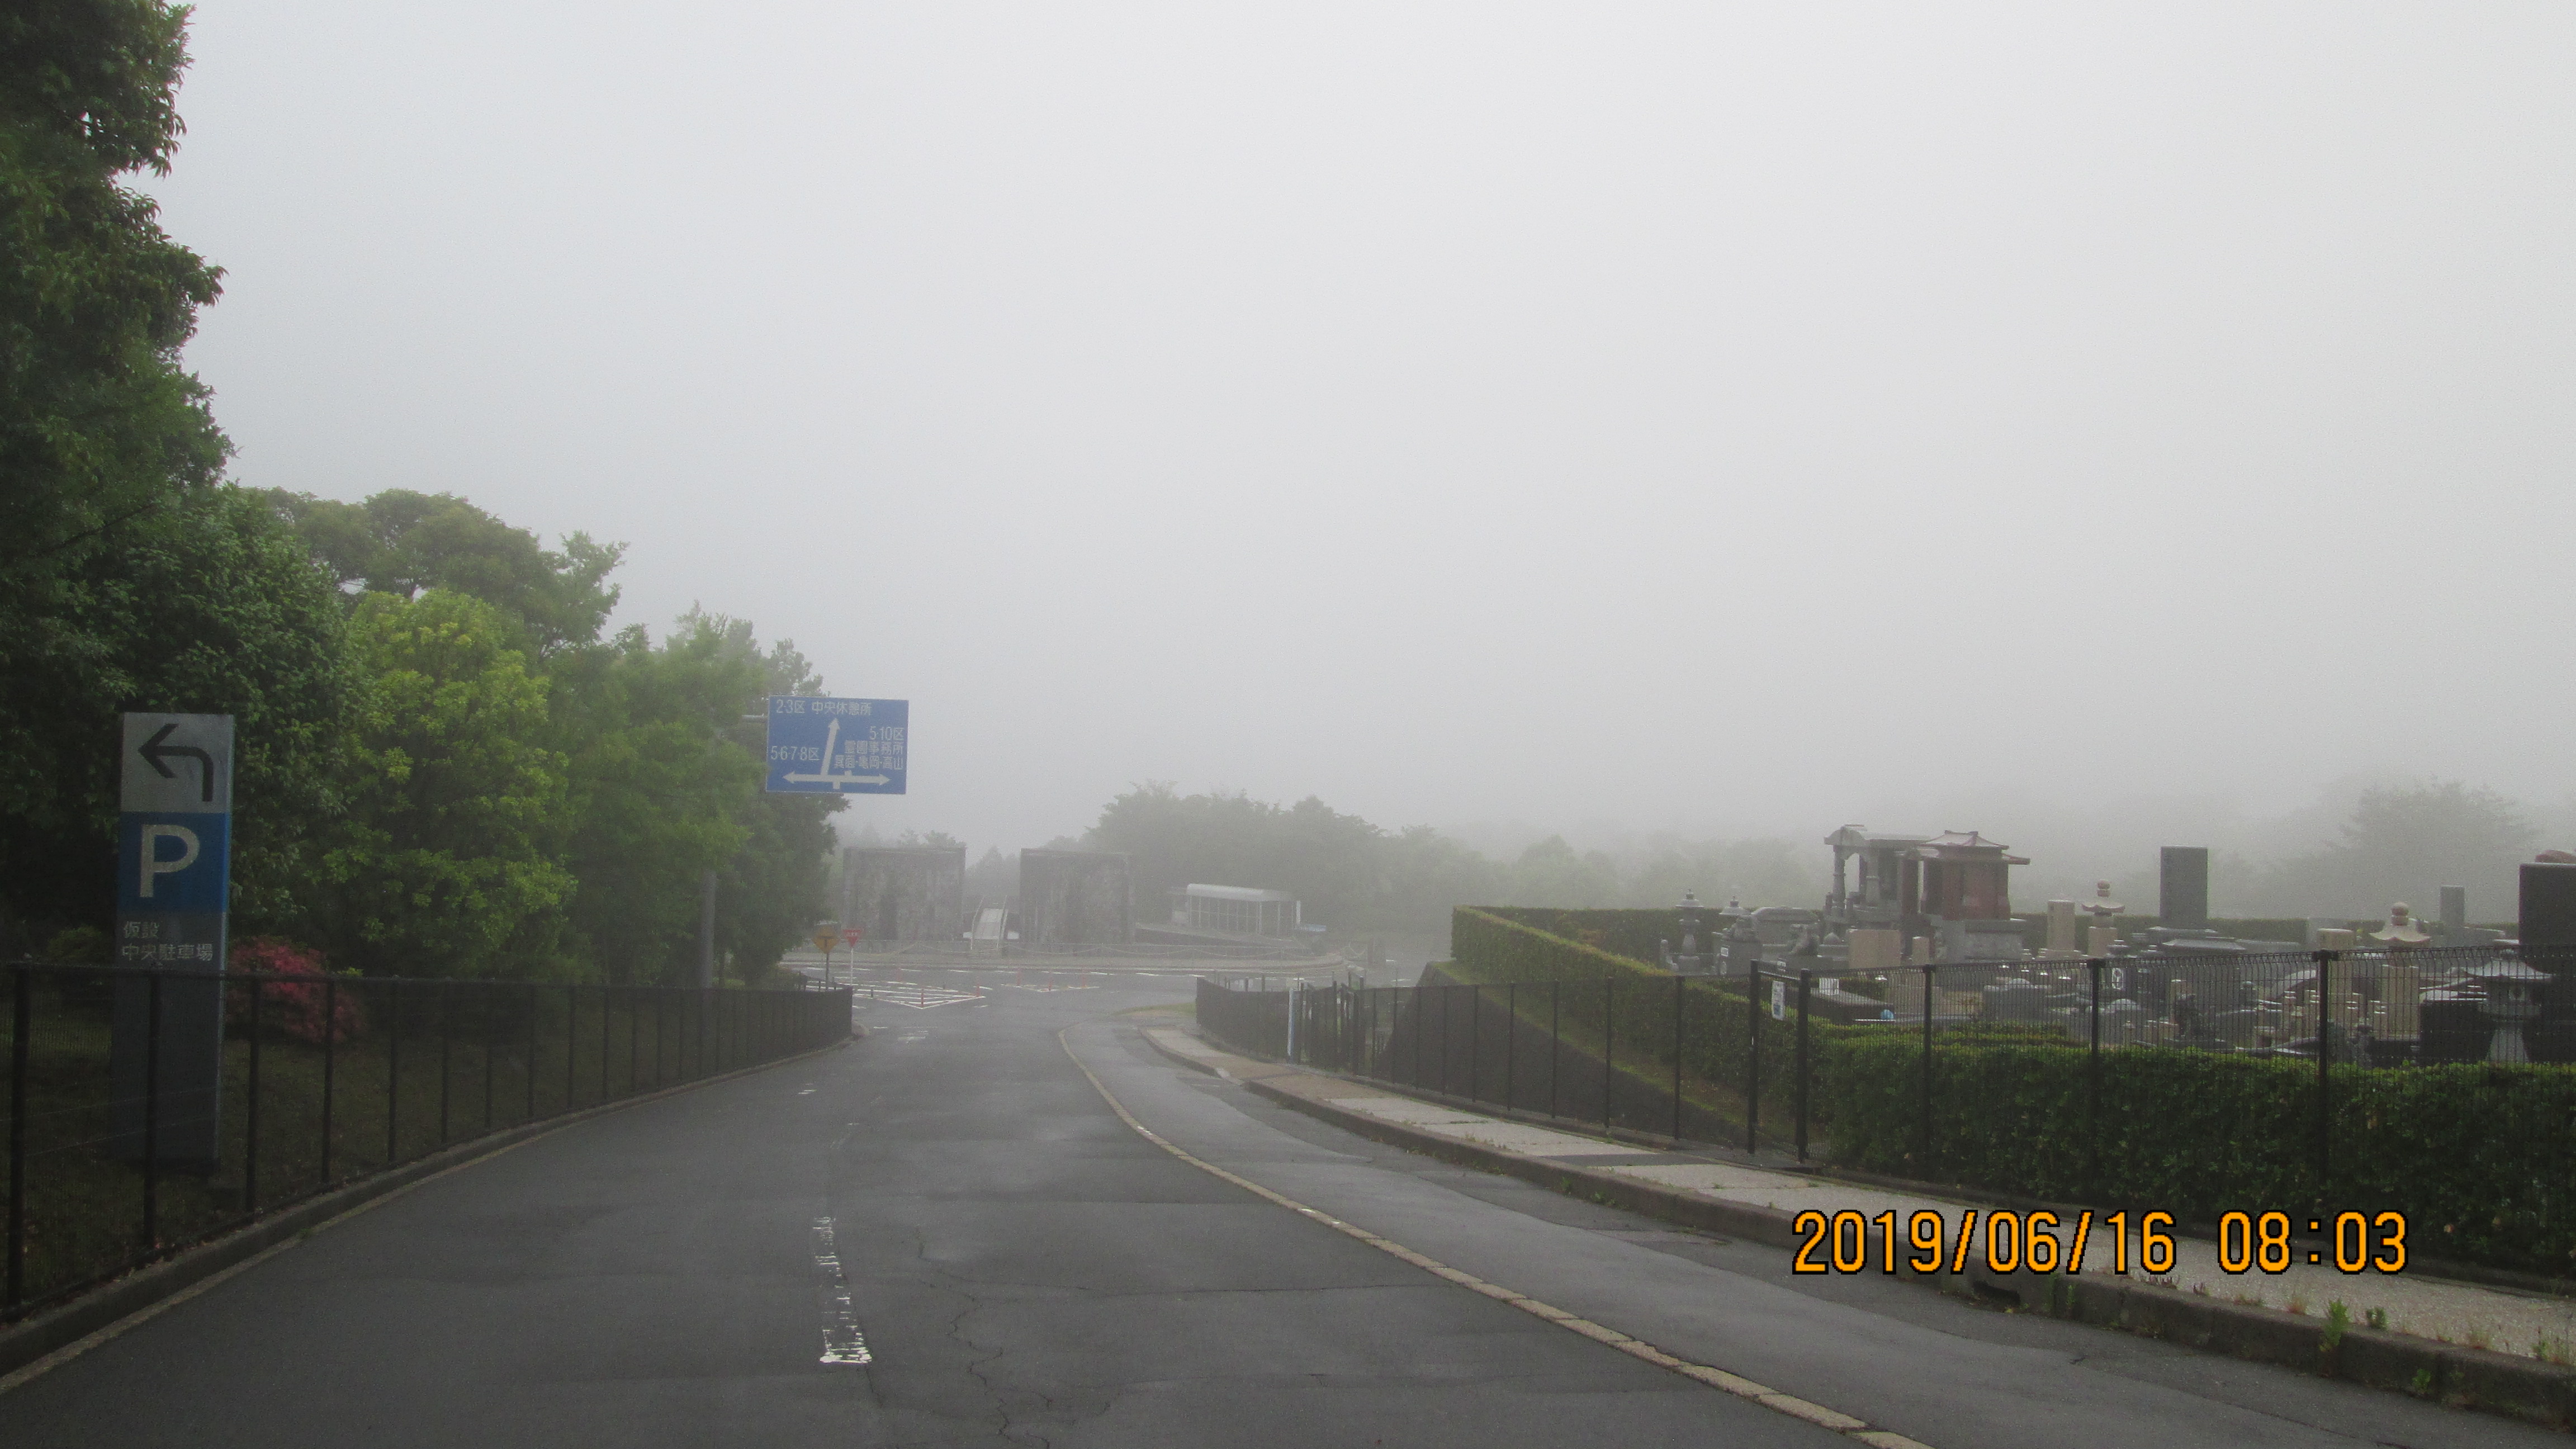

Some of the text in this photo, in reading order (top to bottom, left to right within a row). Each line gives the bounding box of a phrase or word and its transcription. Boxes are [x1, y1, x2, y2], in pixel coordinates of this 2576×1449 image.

[812, 701, 872, 716] 中央休憩所
[140, 824, 200, 898] P
[123, 921, 160, 939] 仮設
[121, 943, 214, 962] 中央駐車場
